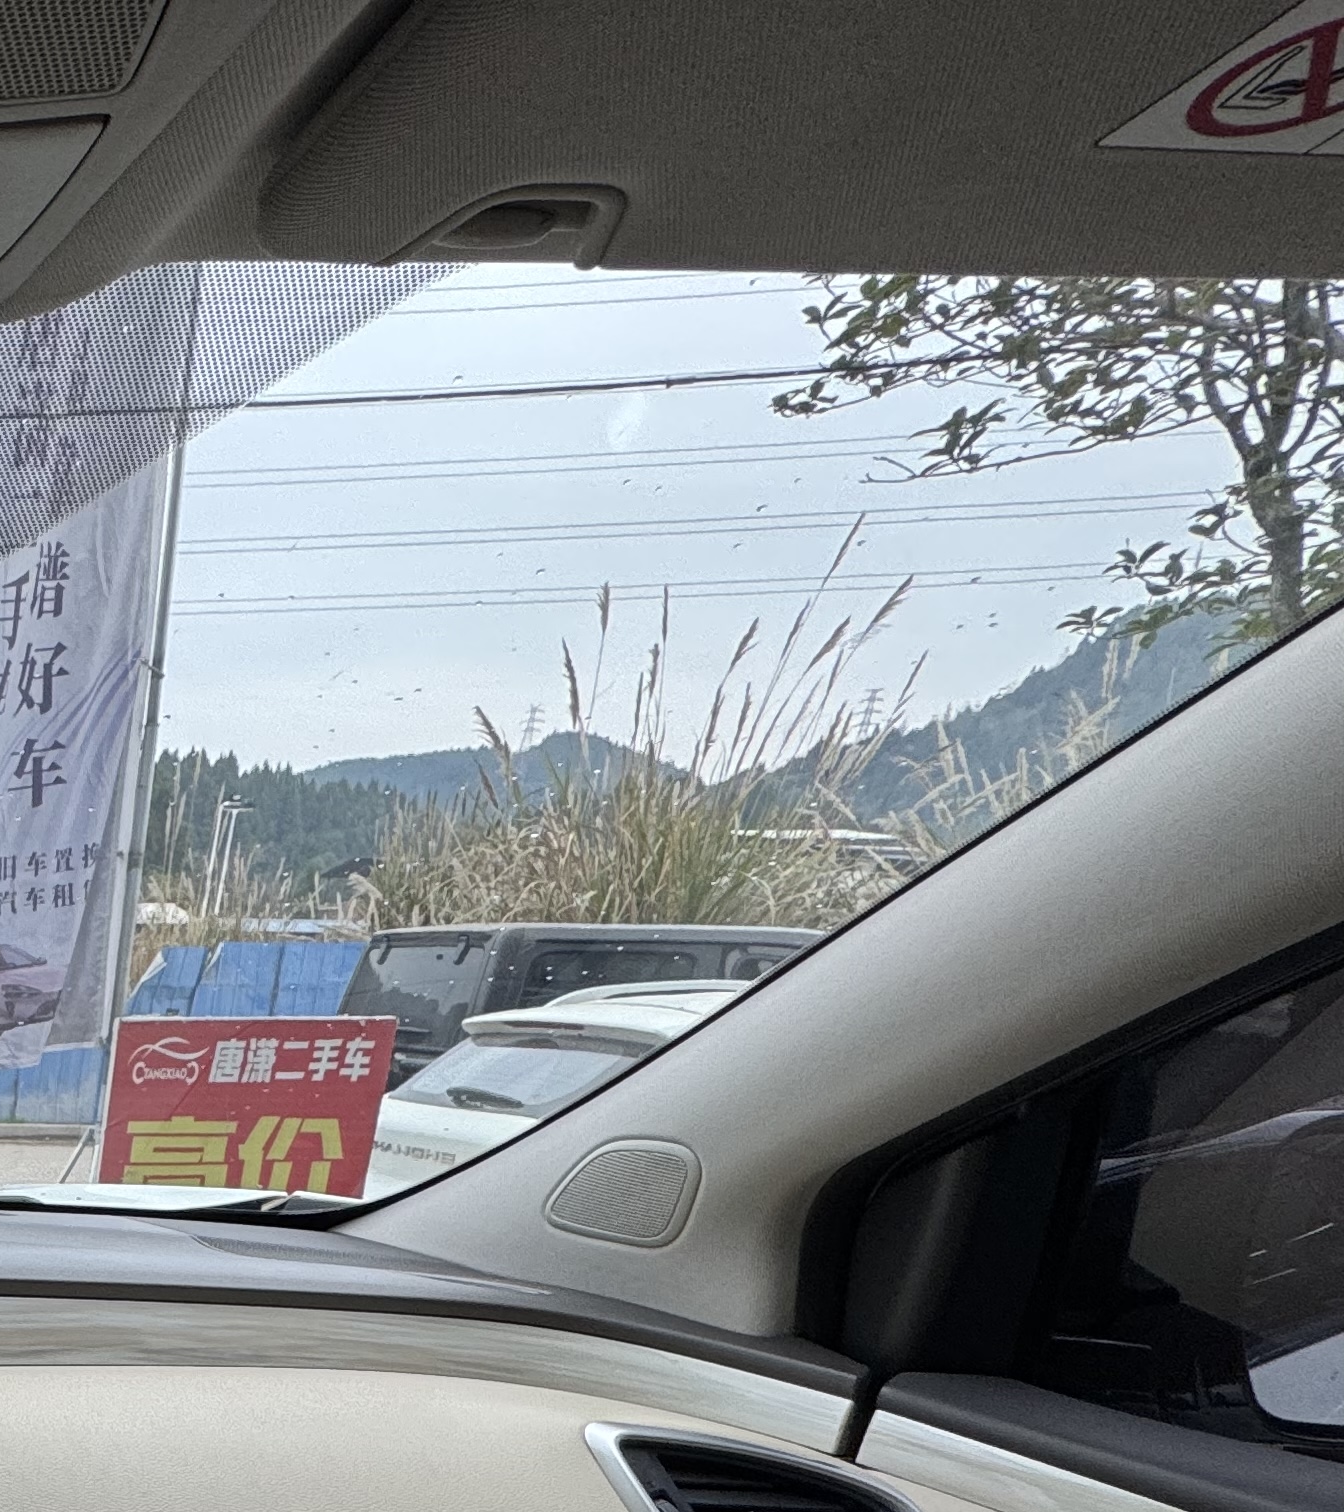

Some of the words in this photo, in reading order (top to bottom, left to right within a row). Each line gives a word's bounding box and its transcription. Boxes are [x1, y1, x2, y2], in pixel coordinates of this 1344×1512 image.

[208, 1037, 376, 1084] 唐潇二手车
[122, 1115, 344, 1194] 高价
